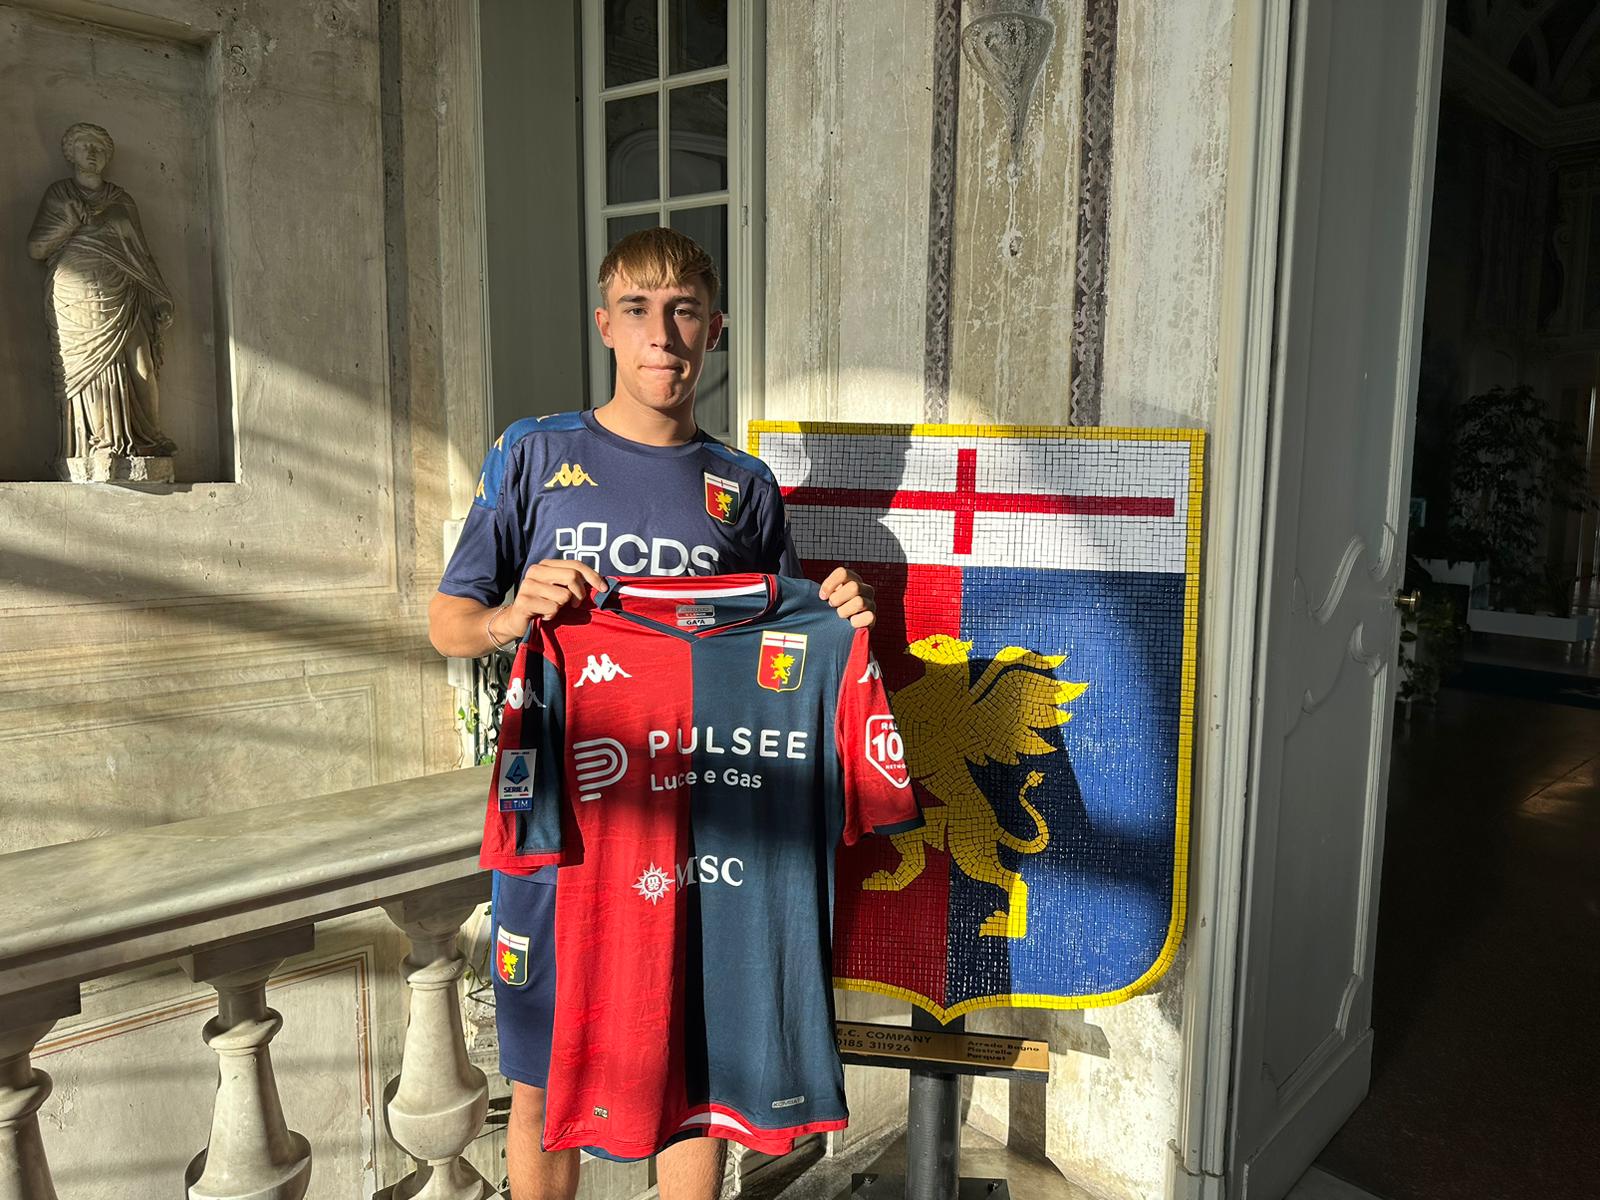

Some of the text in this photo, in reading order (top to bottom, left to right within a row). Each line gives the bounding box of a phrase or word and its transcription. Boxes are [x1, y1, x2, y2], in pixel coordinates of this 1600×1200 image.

[609, 533, 720, 577] CDS
[648, 726, 809, 760] PULSEE
[651, 768, 763, 792] Luce e Gas
[513, 800, 529, 809] TIM
[675, 854, 745, 893] MSC
[866, 1031, 932, 1044] COMPANY
[869, 1041, 911, 1052] 311926
[1007, 1044, 1040, 1052] Bagno
